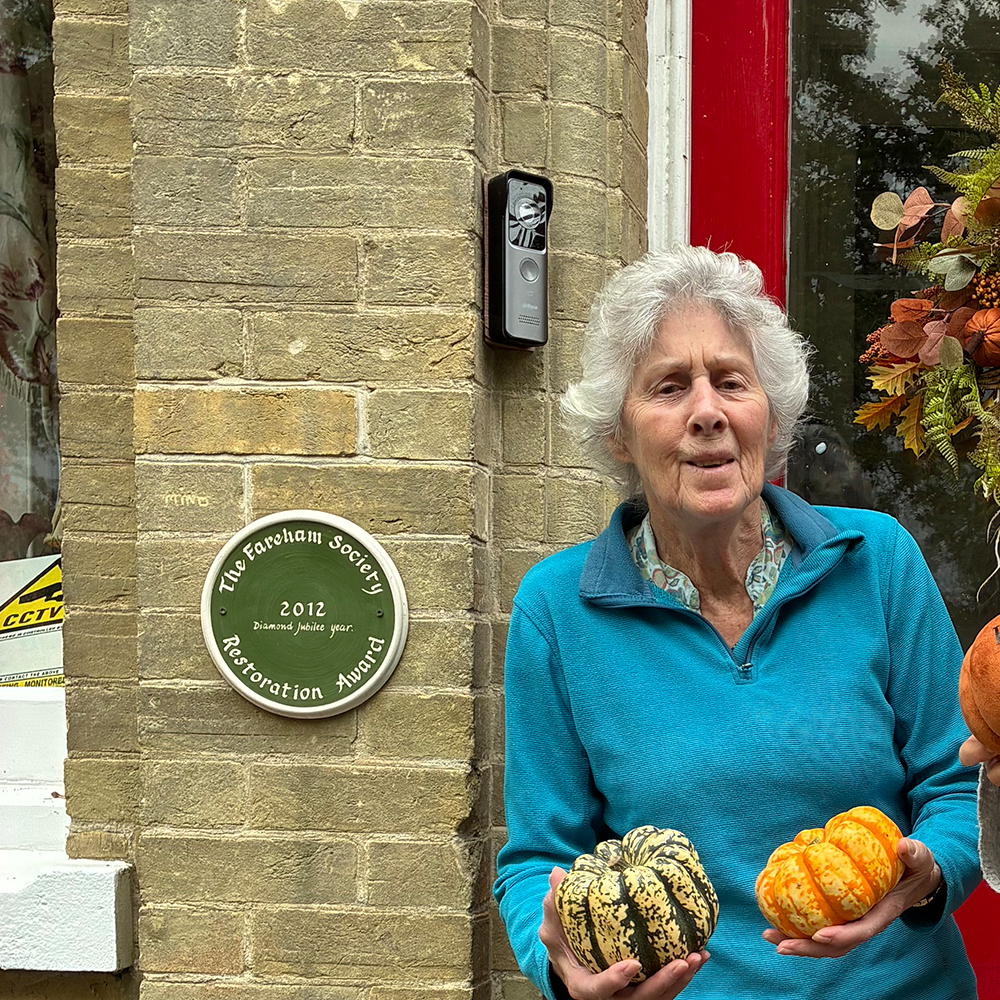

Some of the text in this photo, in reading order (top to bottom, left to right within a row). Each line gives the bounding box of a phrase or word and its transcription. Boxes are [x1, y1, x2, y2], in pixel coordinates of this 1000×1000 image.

[218, 527, 384, 595] The Fareham Society
[3, 604, 63, 627] CCTV
[280, 600, 327, 617] 2012
[253, 620, 354, 639] Diamond Jubilee year.
[222, 634, 385, 700] Restoration Award
